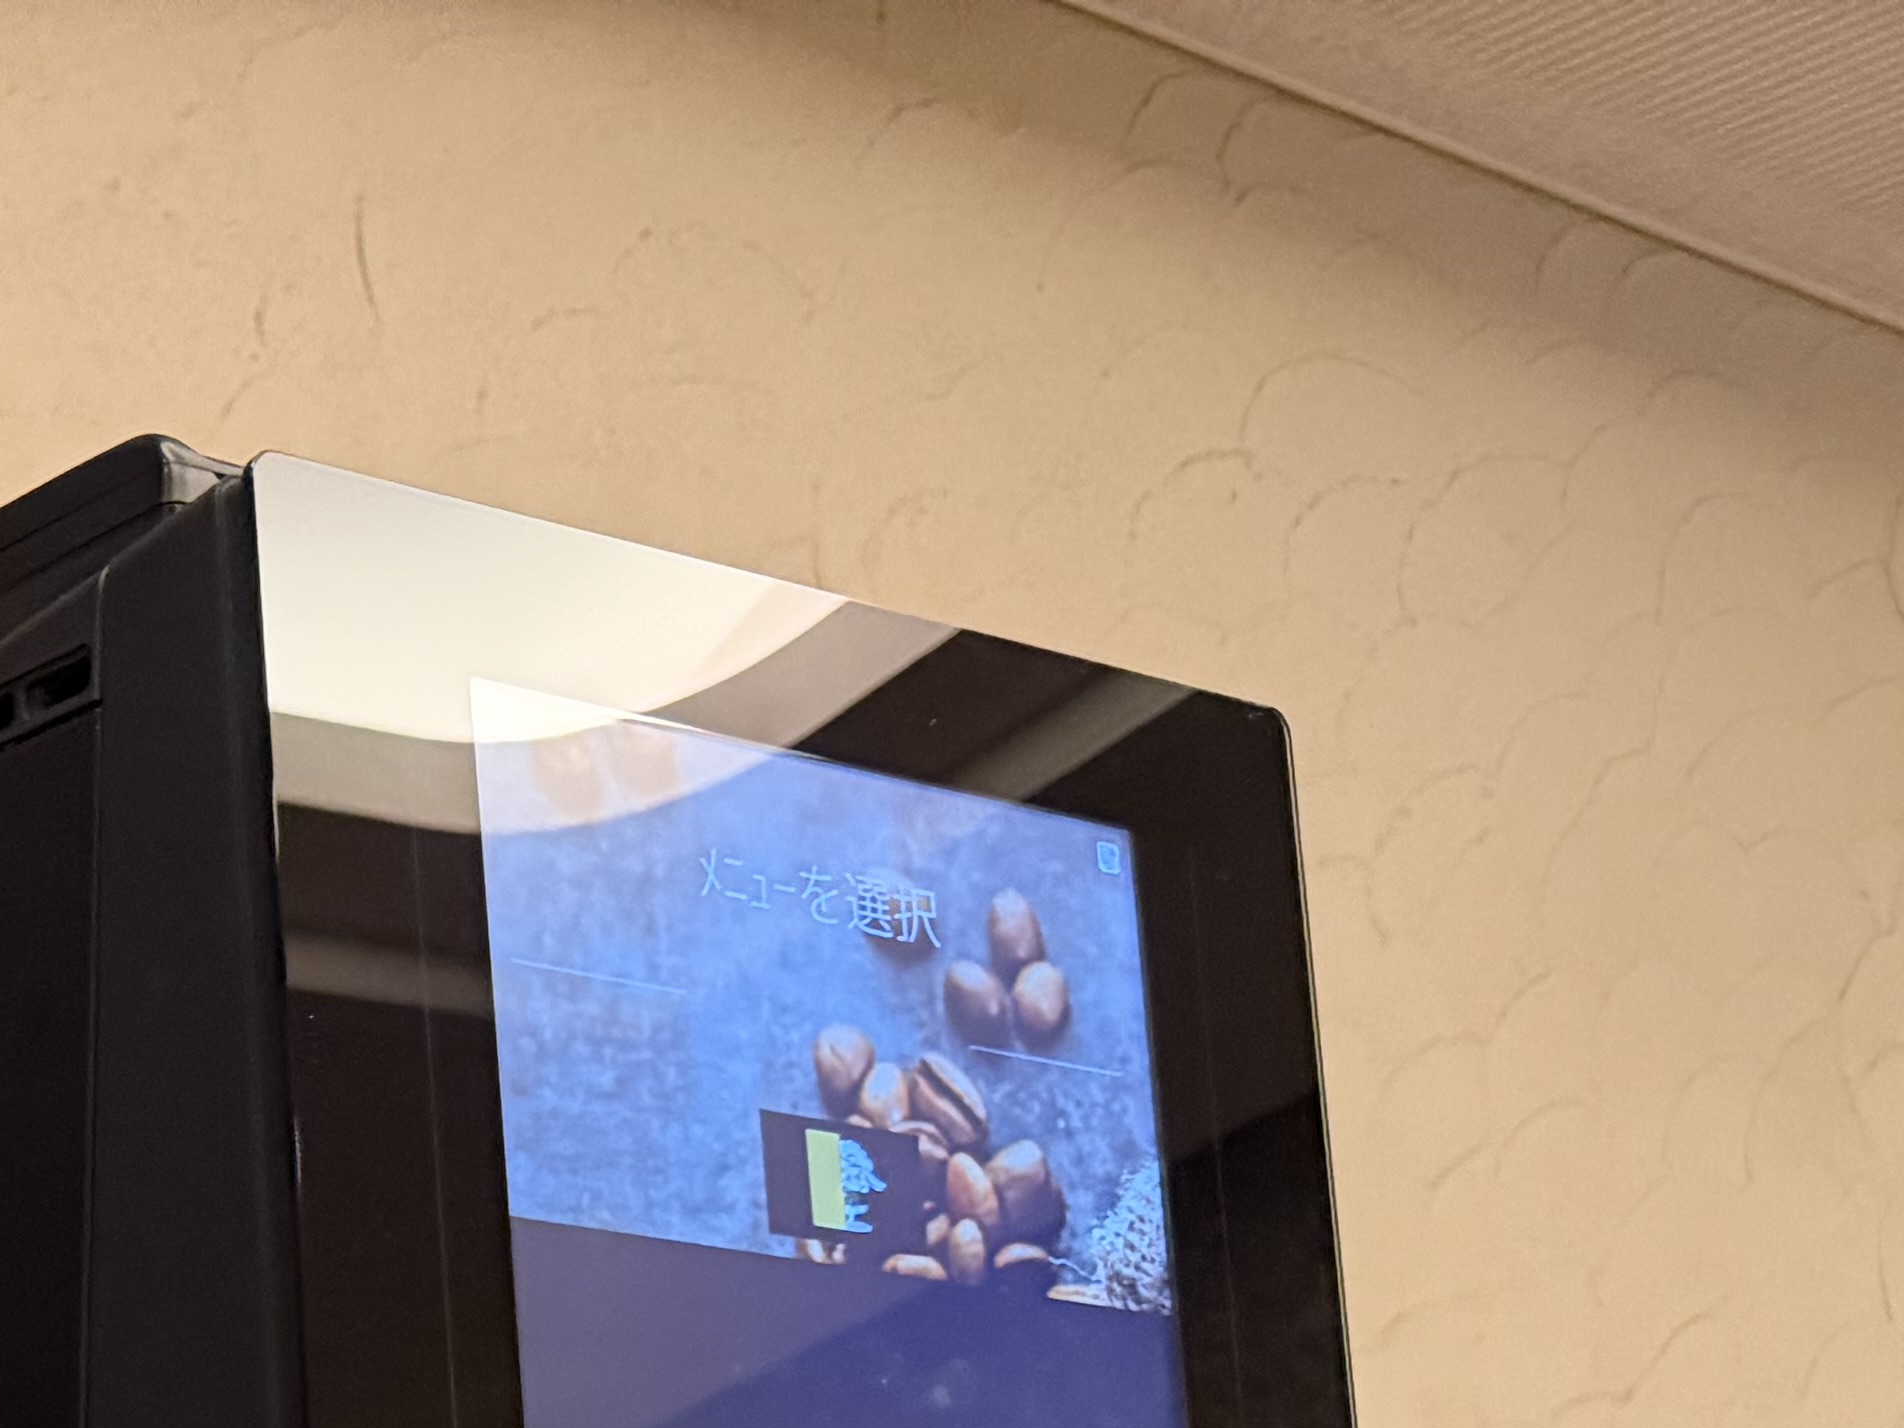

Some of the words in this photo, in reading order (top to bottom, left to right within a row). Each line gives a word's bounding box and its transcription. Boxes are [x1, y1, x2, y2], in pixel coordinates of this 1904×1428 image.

[699, 848, 940, 948] メニューを選択
